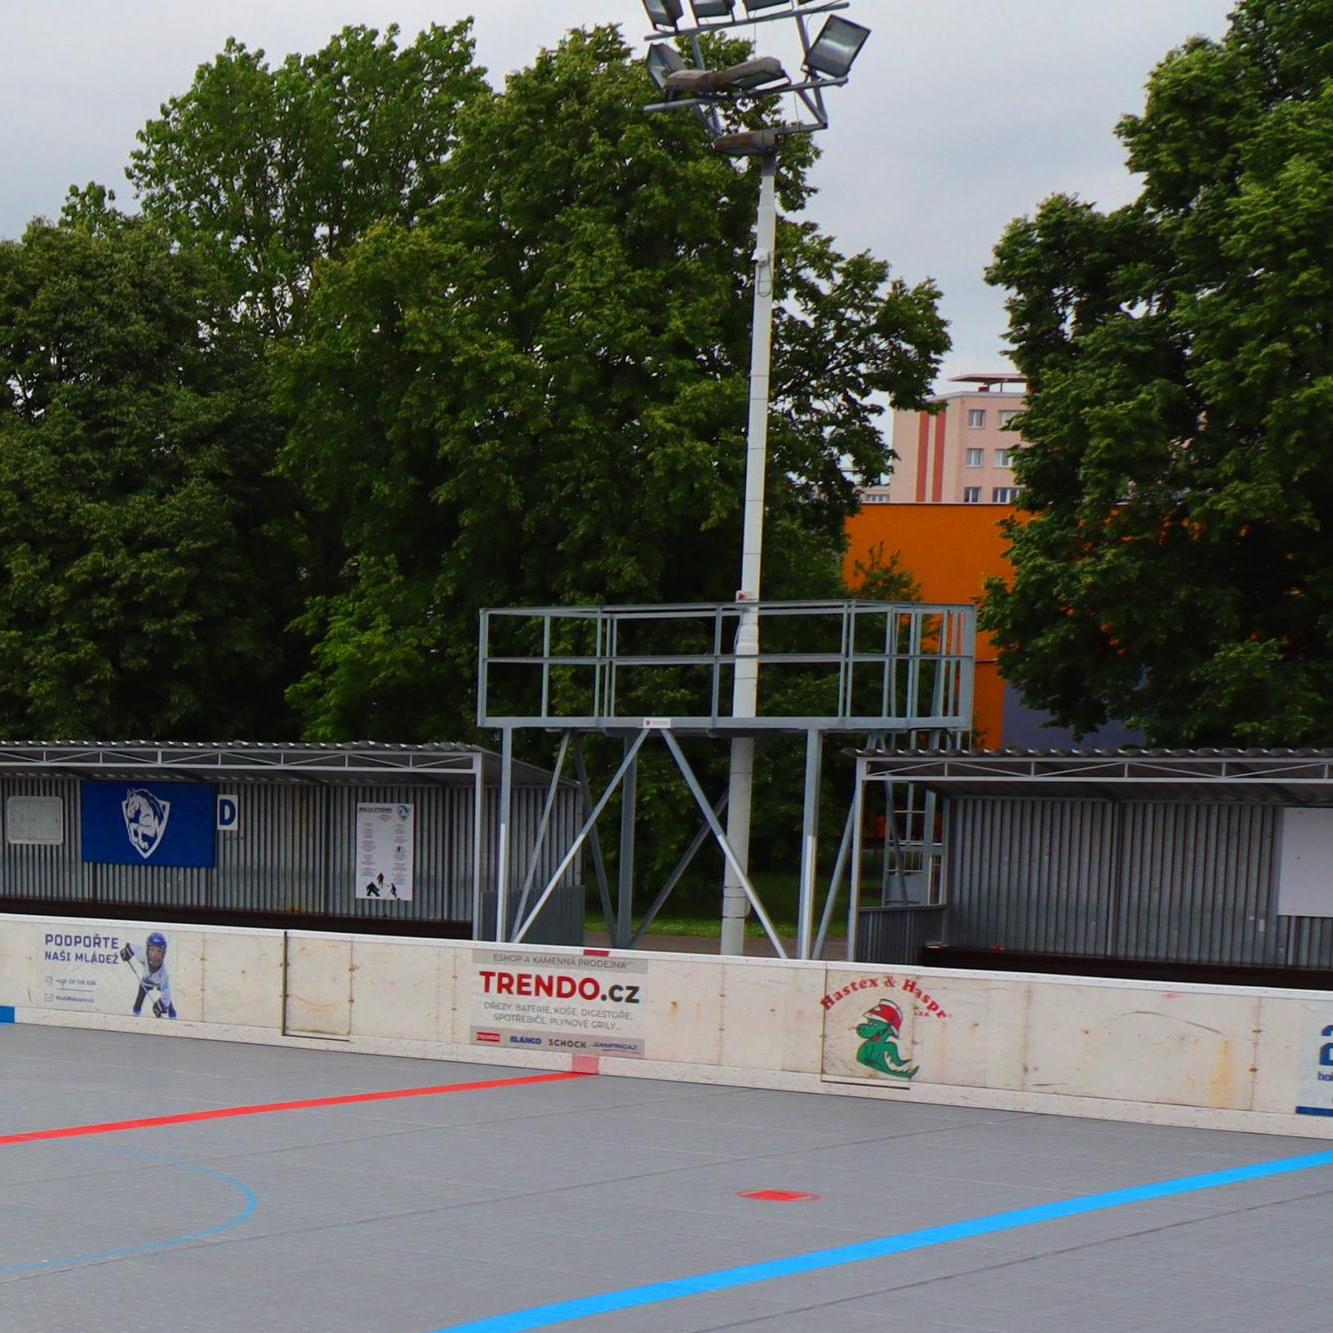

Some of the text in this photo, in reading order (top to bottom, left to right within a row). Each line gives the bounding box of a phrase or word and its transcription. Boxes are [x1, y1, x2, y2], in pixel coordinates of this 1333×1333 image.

[219, 798, 237, 826] D
[44, 933, 120, 949] PODPOŘTE
[44, 950, 120, 965] NAŠI MLÁDEŽ
[492, 953, 524, 963] ESHOP
[533, 956, 577, 967] KAMENNÁ
[819, 975, 947, 1019] Hastex & Haspr
[510, 1034, 542, 1045] BLANCO
[548, 1039, 587, 1049] SCHOCK
